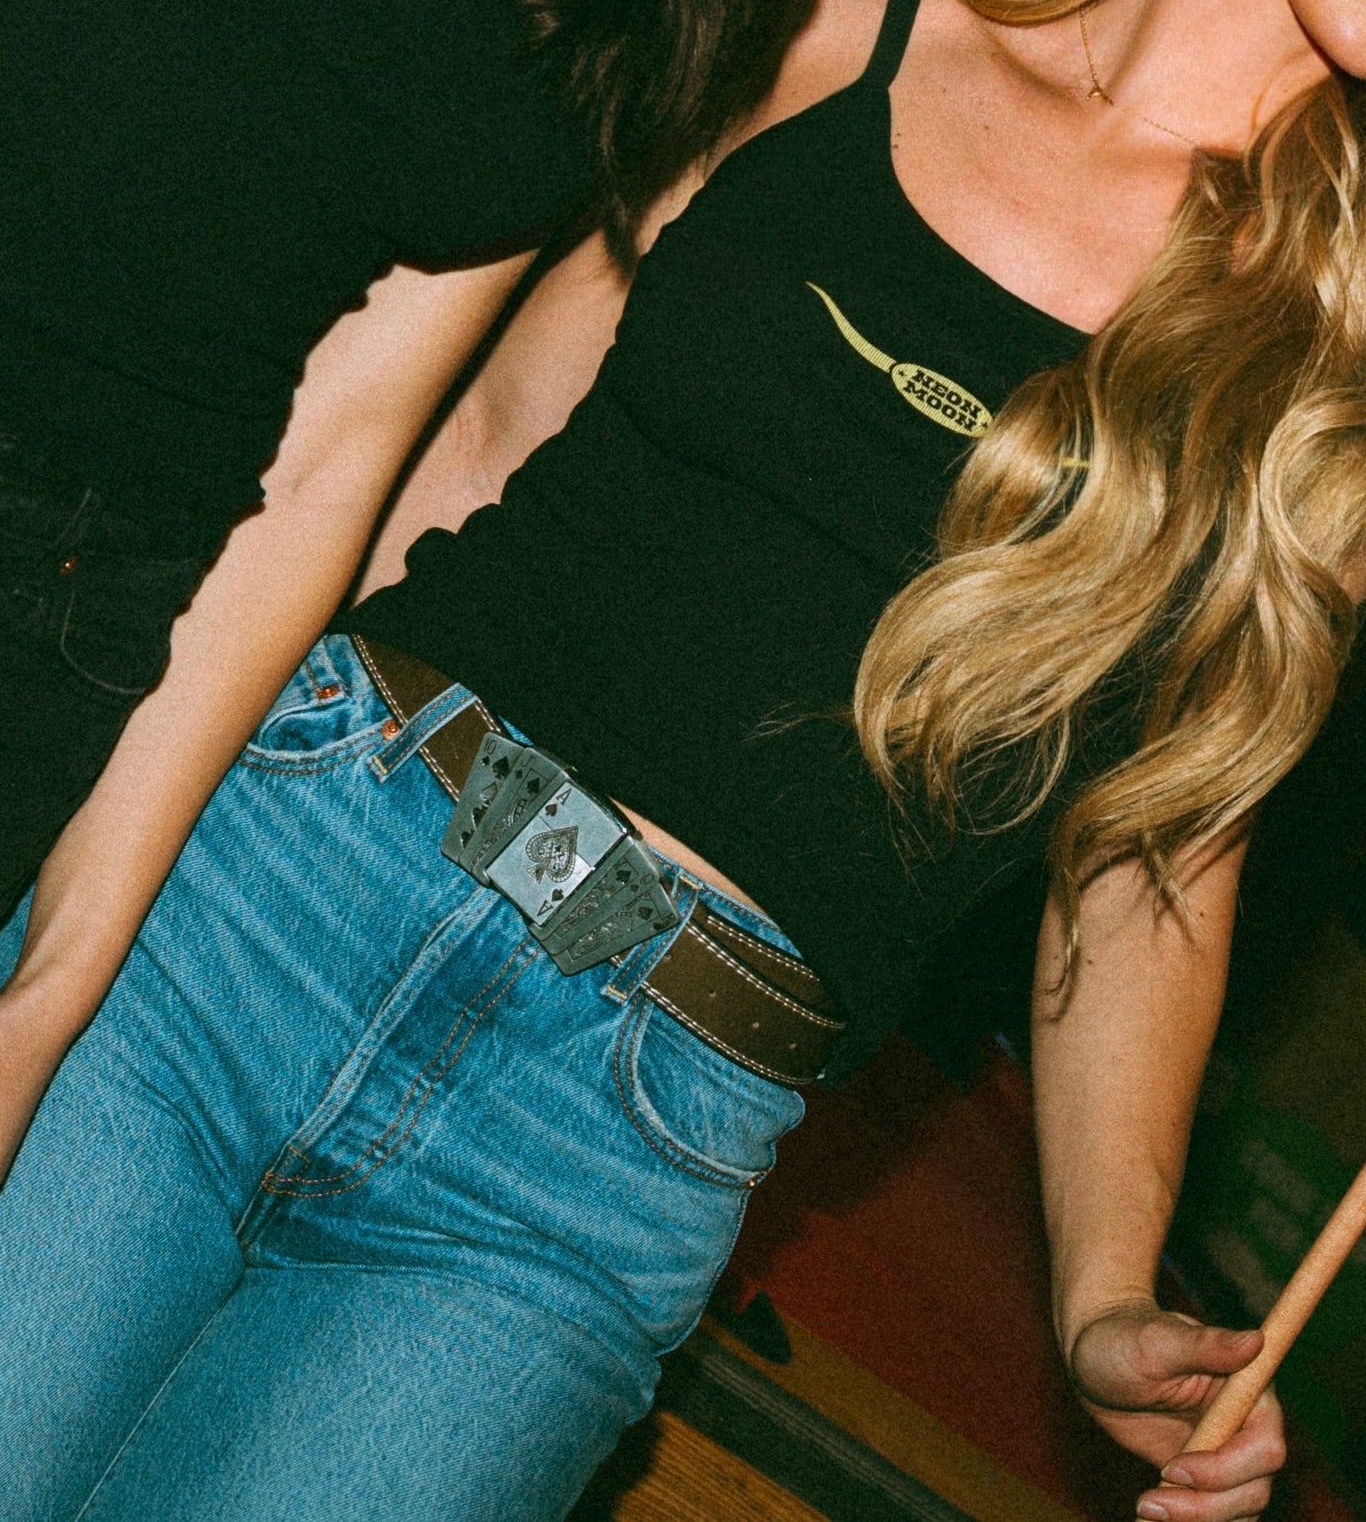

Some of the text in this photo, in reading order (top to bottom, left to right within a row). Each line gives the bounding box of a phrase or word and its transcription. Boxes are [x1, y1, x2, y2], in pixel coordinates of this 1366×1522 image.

[902, 381, 977, 433] MOON
[911, 368, 982, 418] NEON
[554, 788, 573, 806] A
